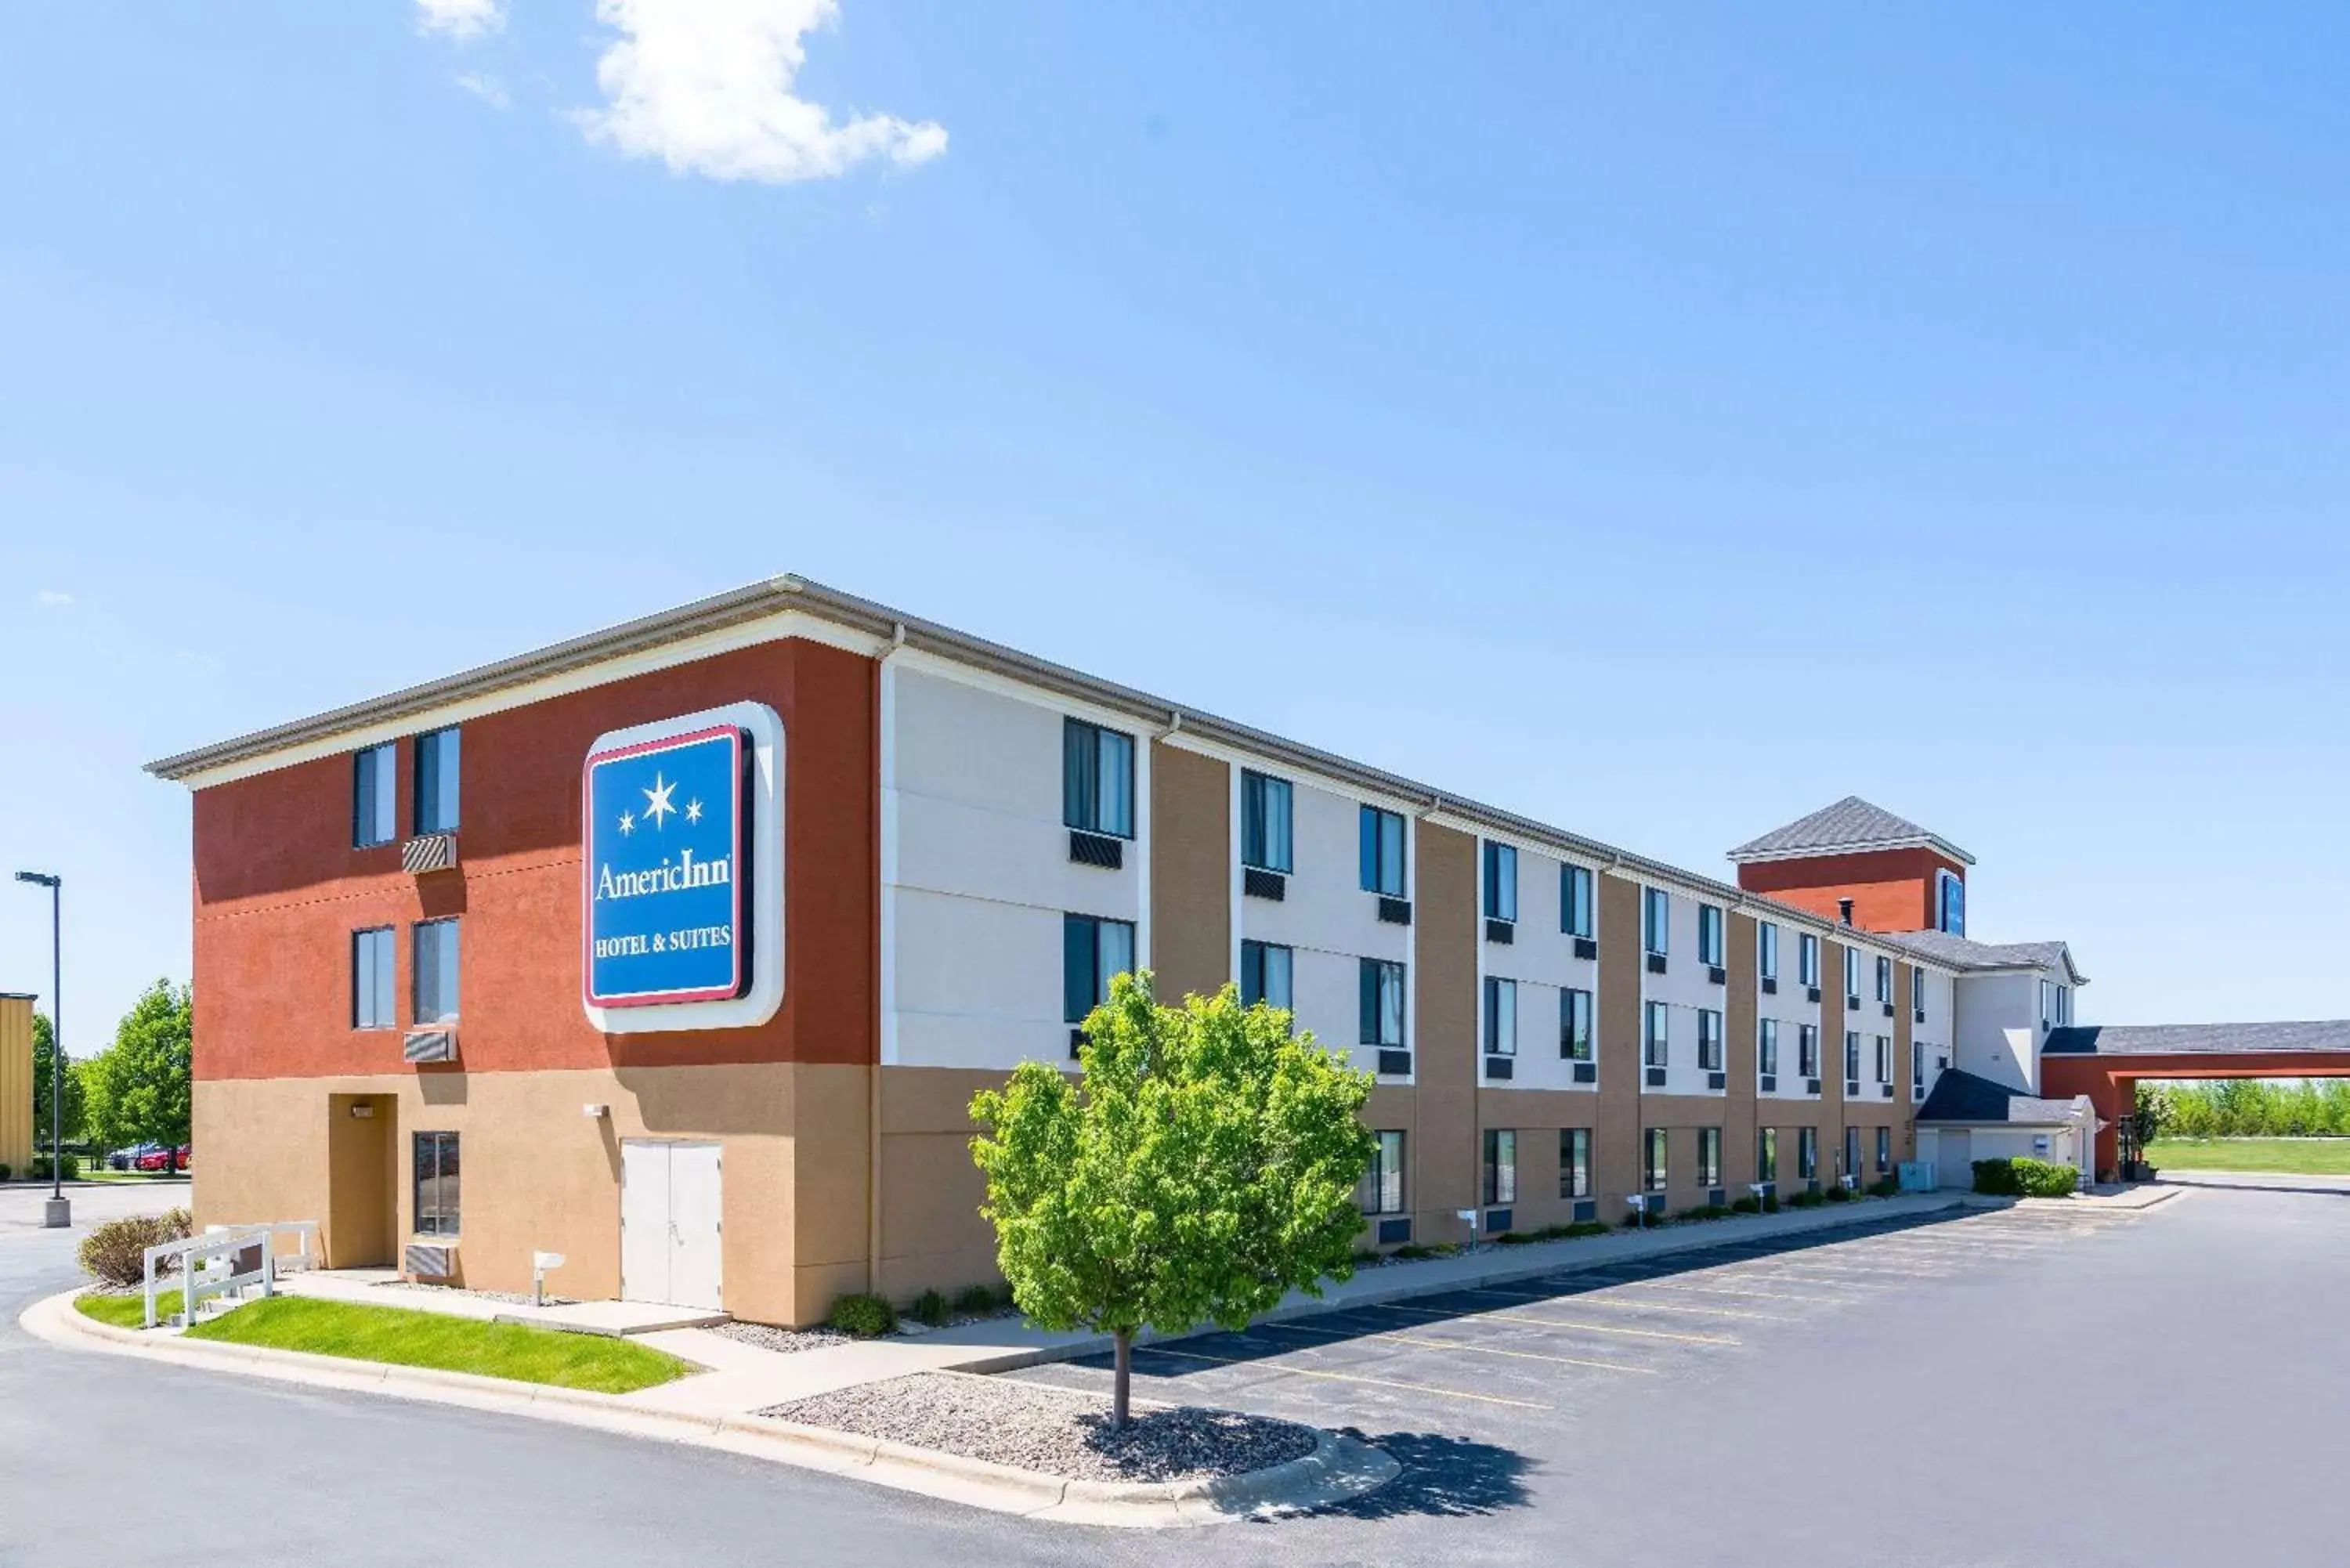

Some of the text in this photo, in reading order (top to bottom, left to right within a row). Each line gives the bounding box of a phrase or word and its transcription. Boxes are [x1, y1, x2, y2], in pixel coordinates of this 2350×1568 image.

[595, 848, 729, 900] AmericInn
[595, 925, 730, 957] HOTEL & SUITES
